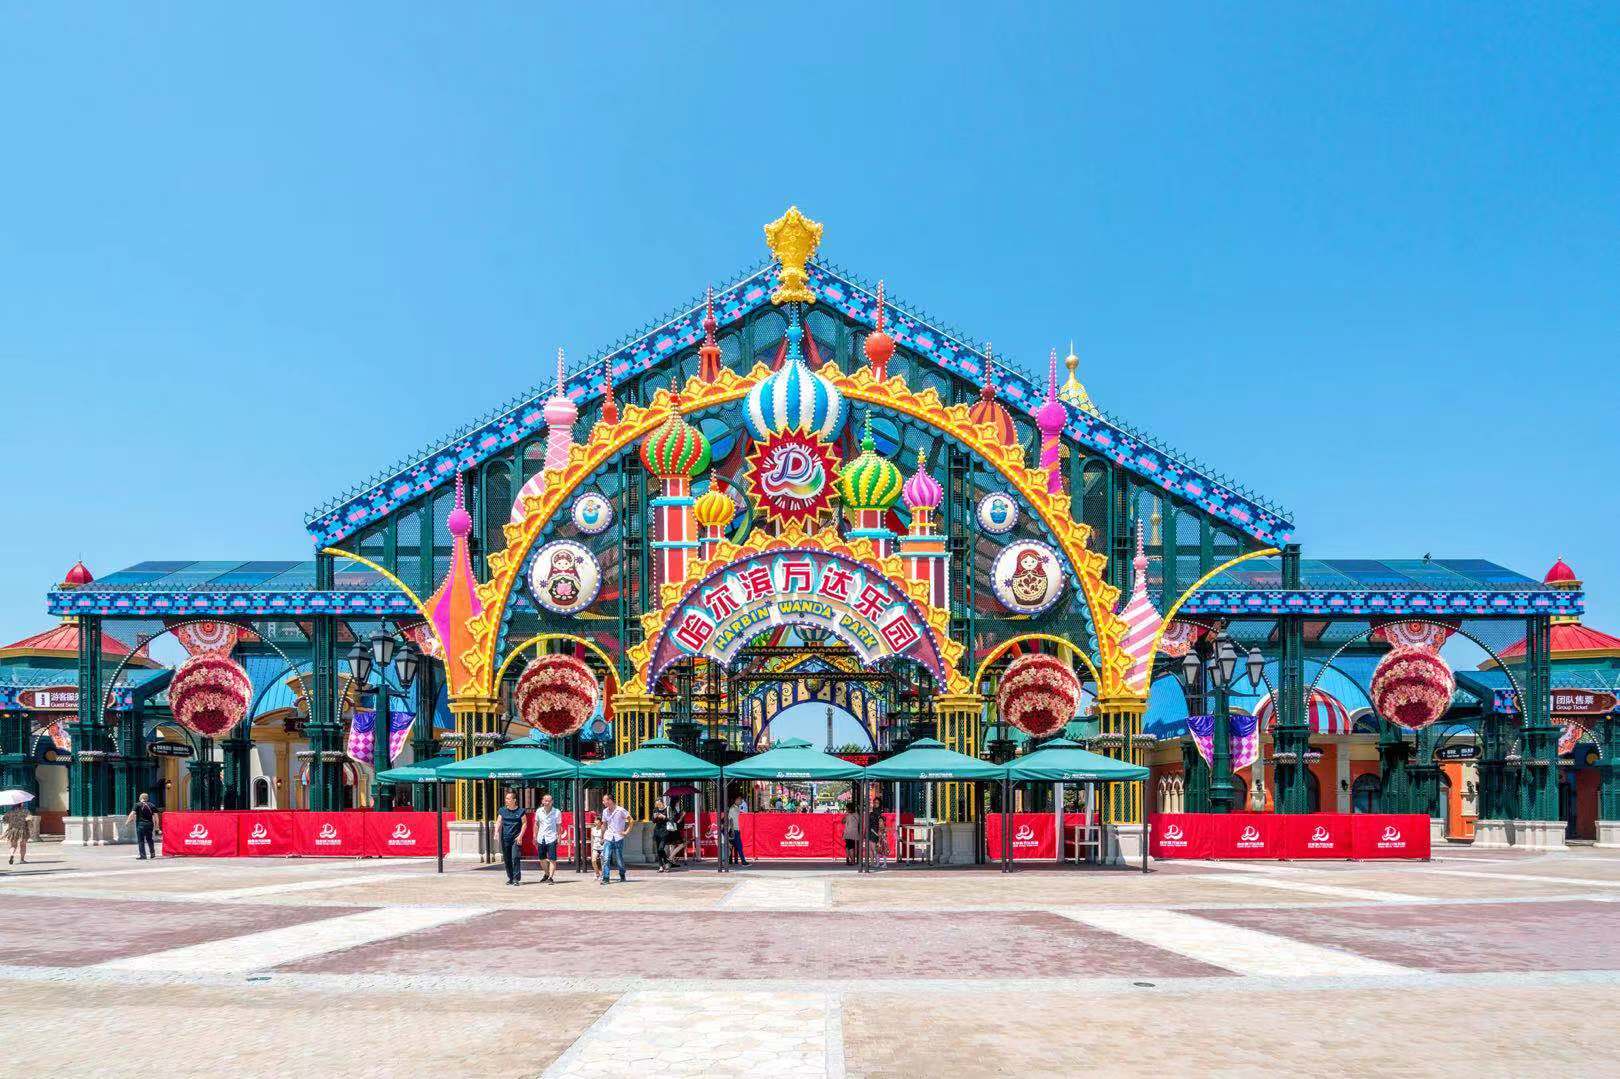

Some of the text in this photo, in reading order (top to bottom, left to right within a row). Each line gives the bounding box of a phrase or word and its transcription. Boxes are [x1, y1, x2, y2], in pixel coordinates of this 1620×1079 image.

[676, 561, 920, 653] 哈尔滨万达乐园
[713, 600, 878, 651] HARBIN WANDA PARK
[1556, 694, 1594, 705] 团队售票
